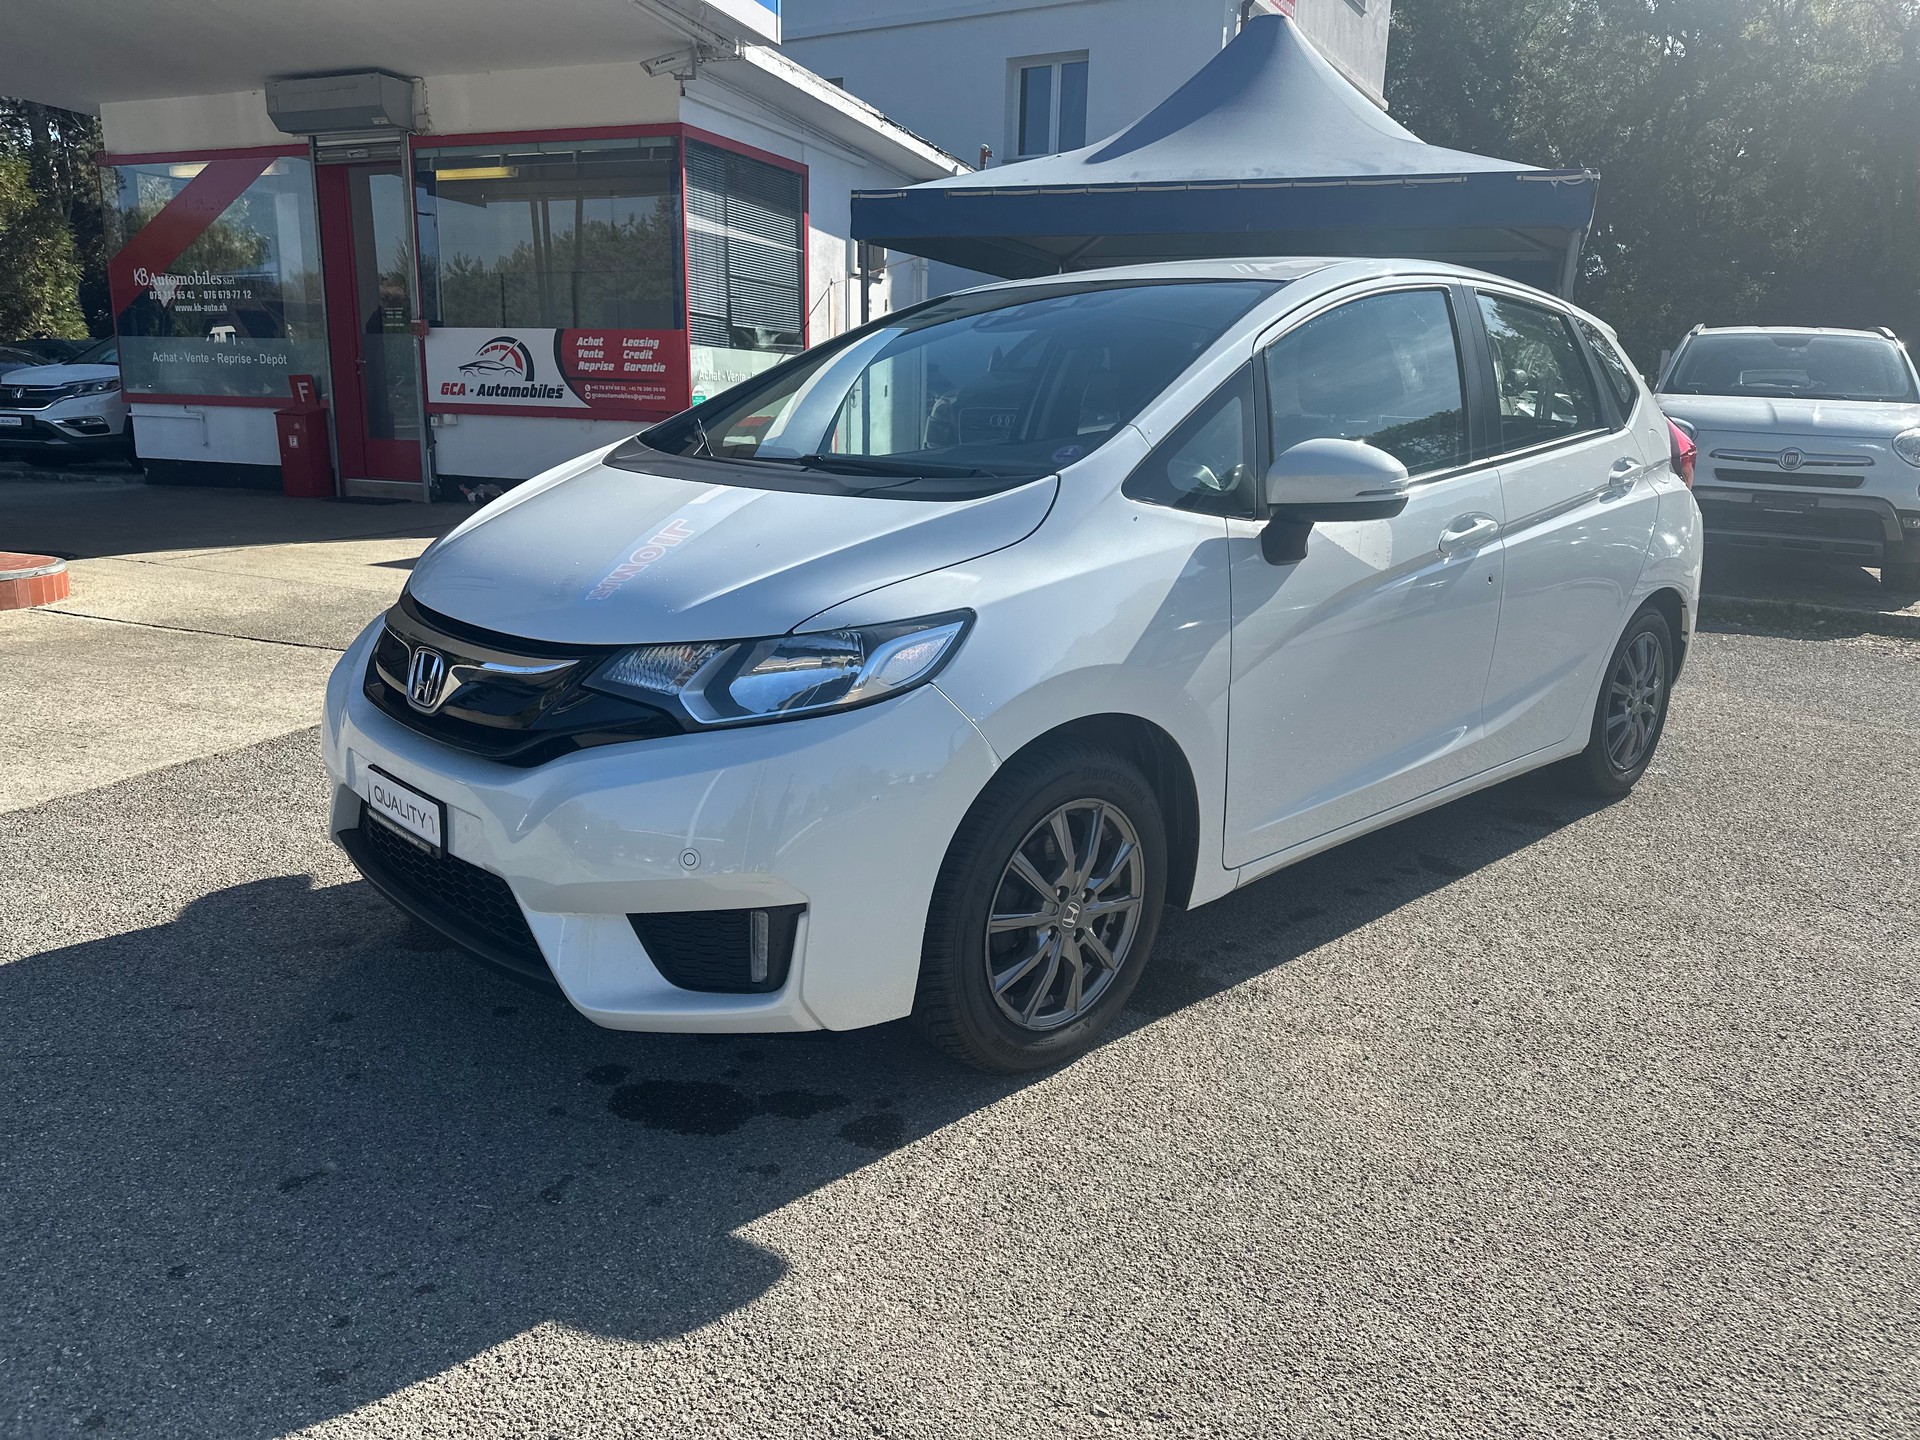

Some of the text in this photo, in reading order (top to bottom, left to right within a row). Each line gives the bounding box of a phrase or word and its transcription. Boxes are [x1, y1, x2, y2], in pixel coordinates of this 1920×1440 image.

[134, 267, 149, 286] KB
[149, 270, 223, 286] Automobiles
[149, 290, 161, 300] 079
[176, 290, 185, 300] 65
[187, 290, 196, 300] 41
[203, 290, 217, 300] 076
[242, 290, 252, 299] 12
[175, 303, 228, 312] www.kb-auto.ch
[576, 336, 659, 349] Achat Leasing
[152, 352, 178, 363] Achat
[184, 352, 209, 363] Vente
[217, 353, 251, 365] Reprise
[260, 353, 287, 367] Dépôt
[578, 349, 653, 360] Vente Credit
[578, 361, 666, 373] Reprise Garantie
[698, 369, 720, 382] Achat
[726, 370, 746, 382] Vente
[297, 382, 308, 403] F
[440, 382, 466, 396] GCA
[476, 383, 564, 399] Automobiles
[1785, 454, 1797, 463] FIAT
